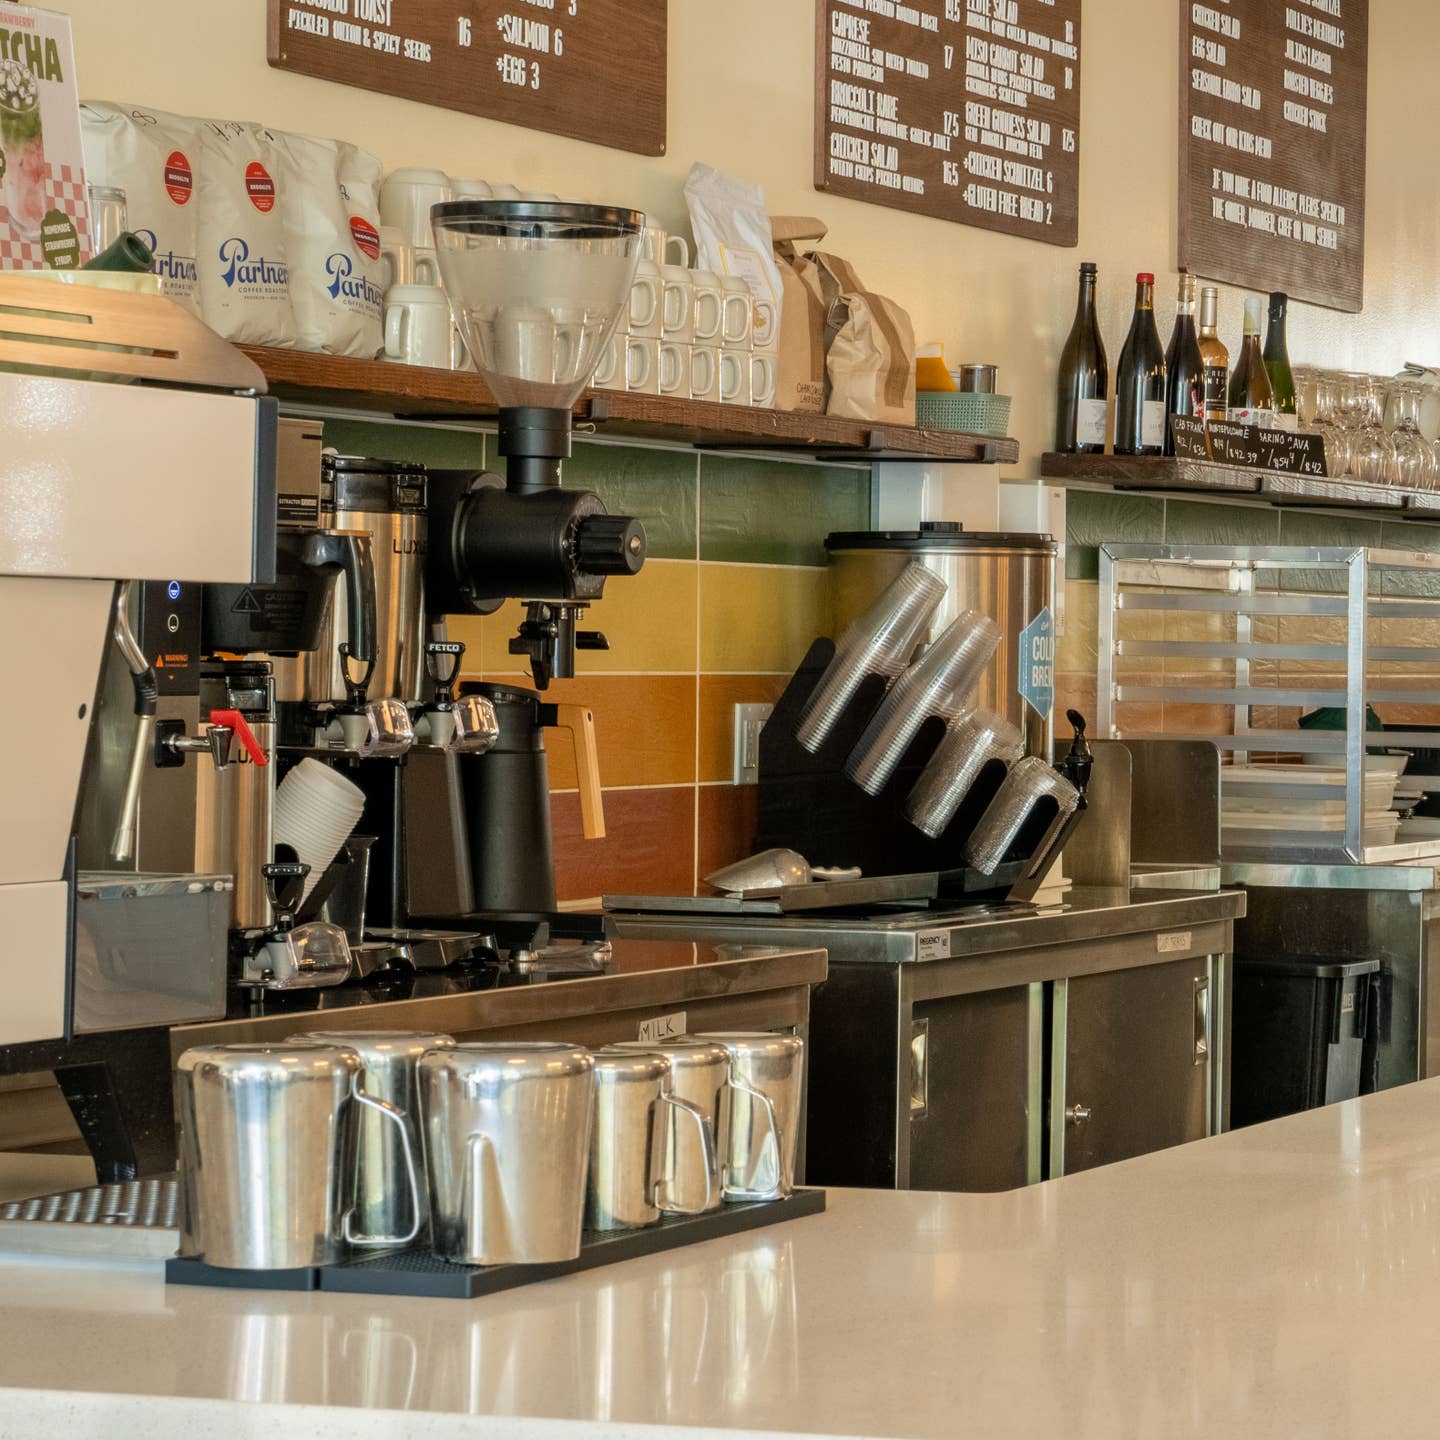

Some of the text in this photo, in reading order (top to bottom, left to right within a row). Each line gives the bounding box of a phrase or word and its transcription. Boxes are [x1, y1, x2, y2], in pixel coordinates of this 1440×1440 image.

[362, 28, 371, 48] &
[373, 30, 401, 55] SPICY
[457, 16, 472, 47] 16
[554, 28, 563, 56] 6
[831, 10, 954, 70] CAPRESE 17
[530, 62, 540, 90] 3
[870, 142, 899, 172] SALAD
[1046, 202, 1053, 225] 2
[429, 643, 460, 653] FETCO
[640, 1017, 674, 1041] MILK
